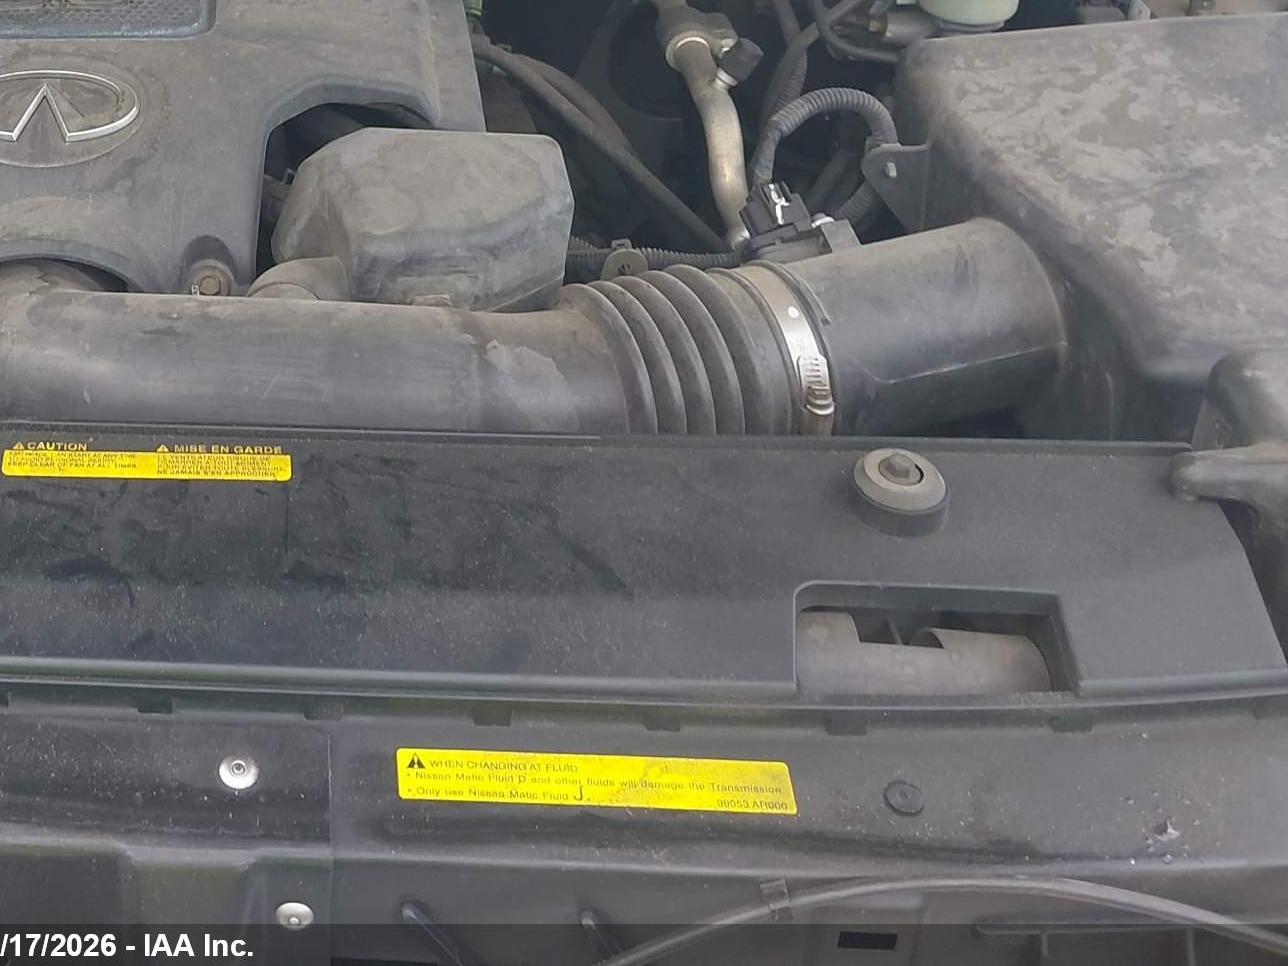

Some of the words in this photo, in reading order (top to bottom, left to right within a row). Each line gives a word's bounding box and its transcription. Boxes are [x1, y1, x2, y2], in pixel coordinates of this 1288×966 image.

[27, 441, 88, 451] CAUTION
[174, 444, 206, 453] MISE
[212, 444, 229, 453] EN
[233, 445, 282, 454] GARDE
[466, 760, 527, 771] CHANGING
[529, 762, 541, 771] AT
[545, 763, 578, 773] FLUID
[415, 771, 451, 780] Nissan
[488, 773, 514, 783] Fluid
[531, 775, 551, 784] and
[619, 779, 638, 788] will
[640, 780, 684, 791] damage
[688, 781, 705, 791] the
[416, 787, 440, 797] Only
[468, 788, 505, 798] Nissan
[509, 790, 538, 800] Matic
[542, 792, 569, 801] Fluid
